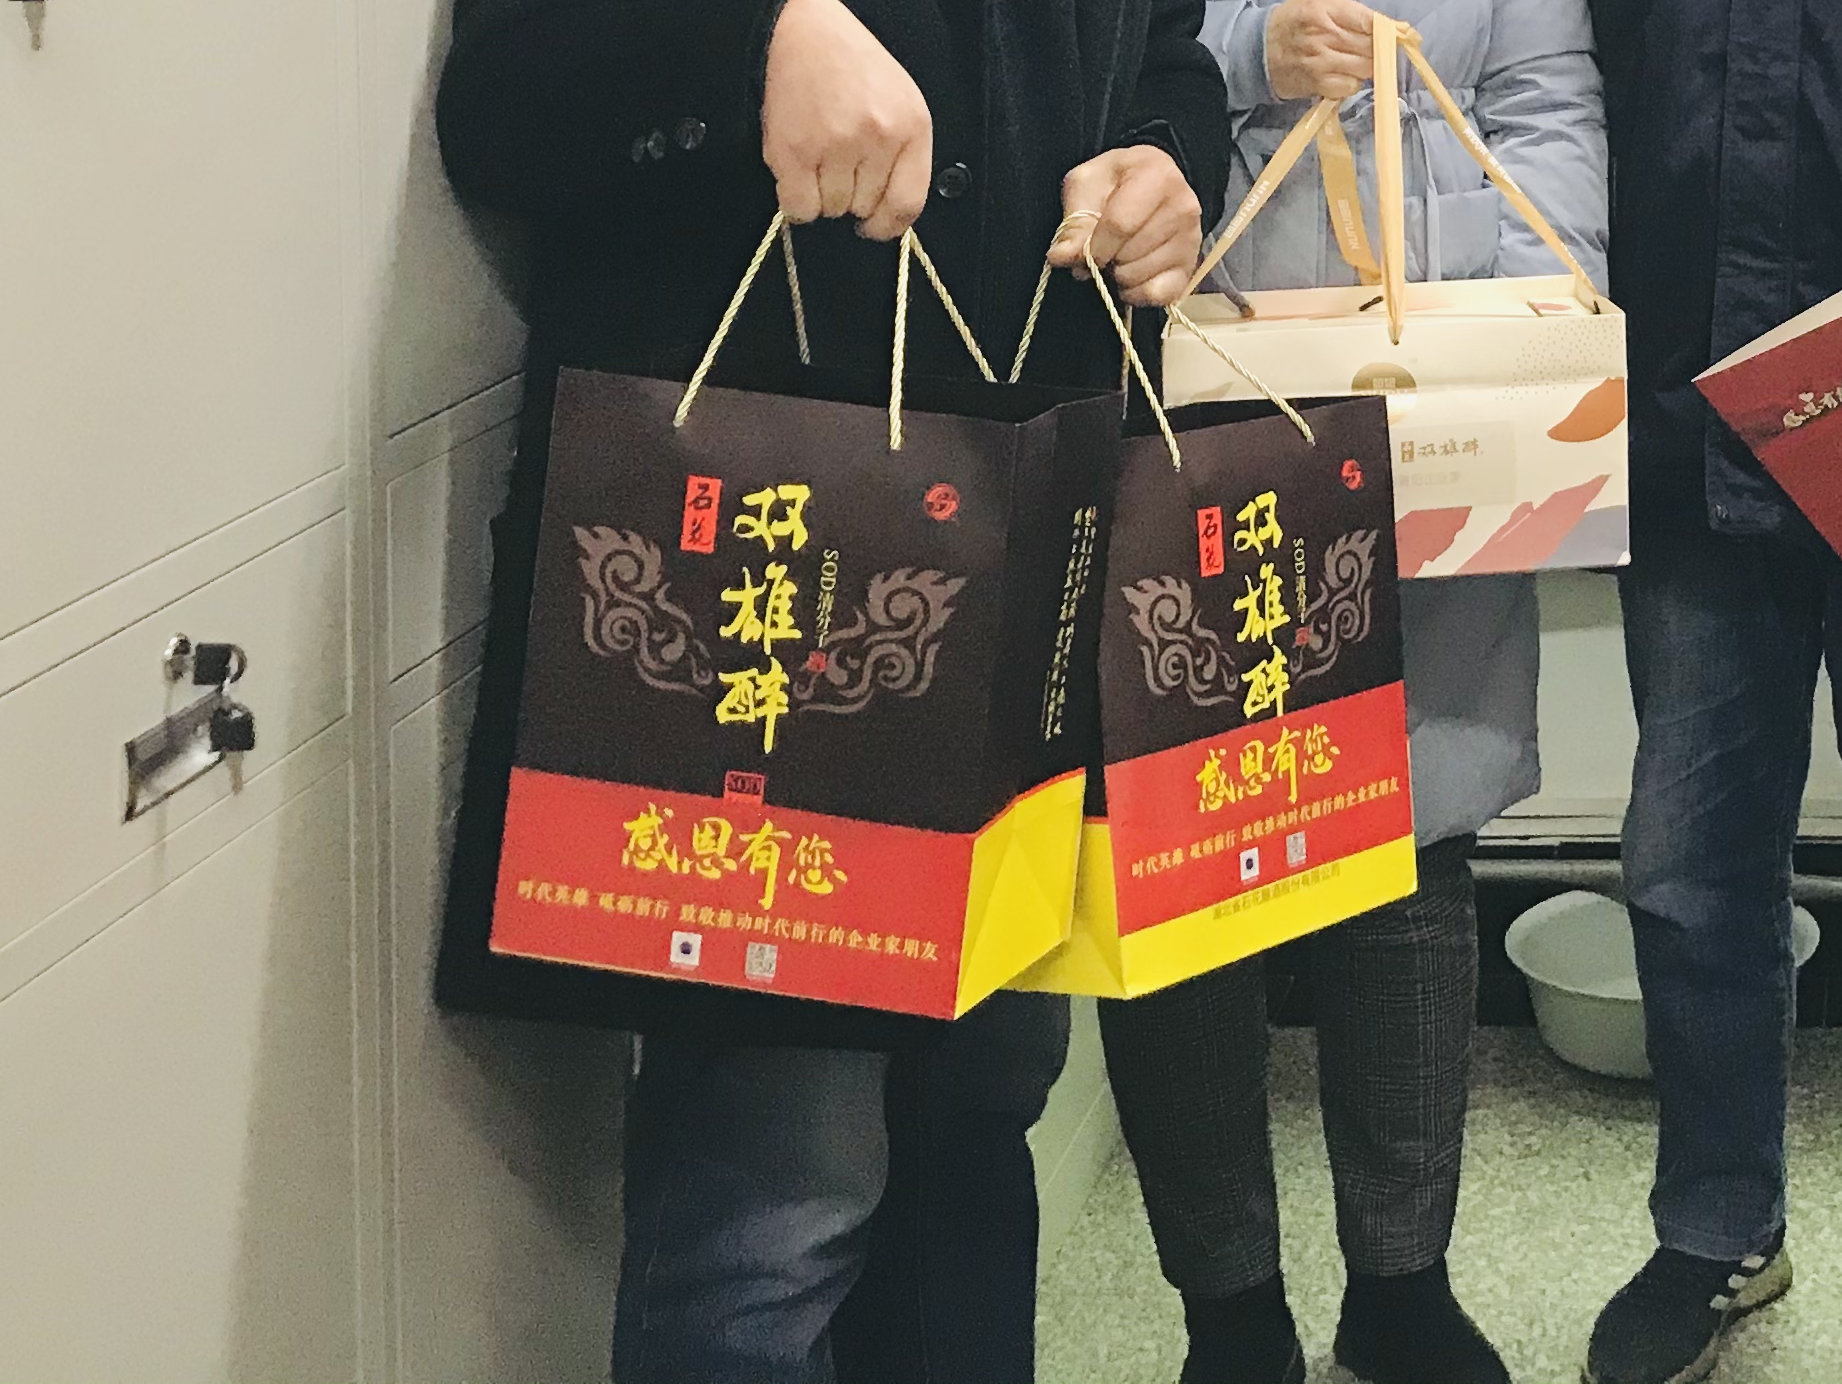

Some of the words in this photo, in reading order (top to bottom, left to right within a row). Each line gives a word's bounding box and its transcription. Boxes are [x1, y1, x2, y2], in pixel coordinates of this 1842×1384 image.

[716, 484, 811, 753] 双雄醉
[1234, 491, 1291, 717] 双雄醉
[1196, 723, 1341, 813] 感恩有您
[516, 879, 590, 907] 时代英雄
[621, 802, 848, 910] 感恩有您
